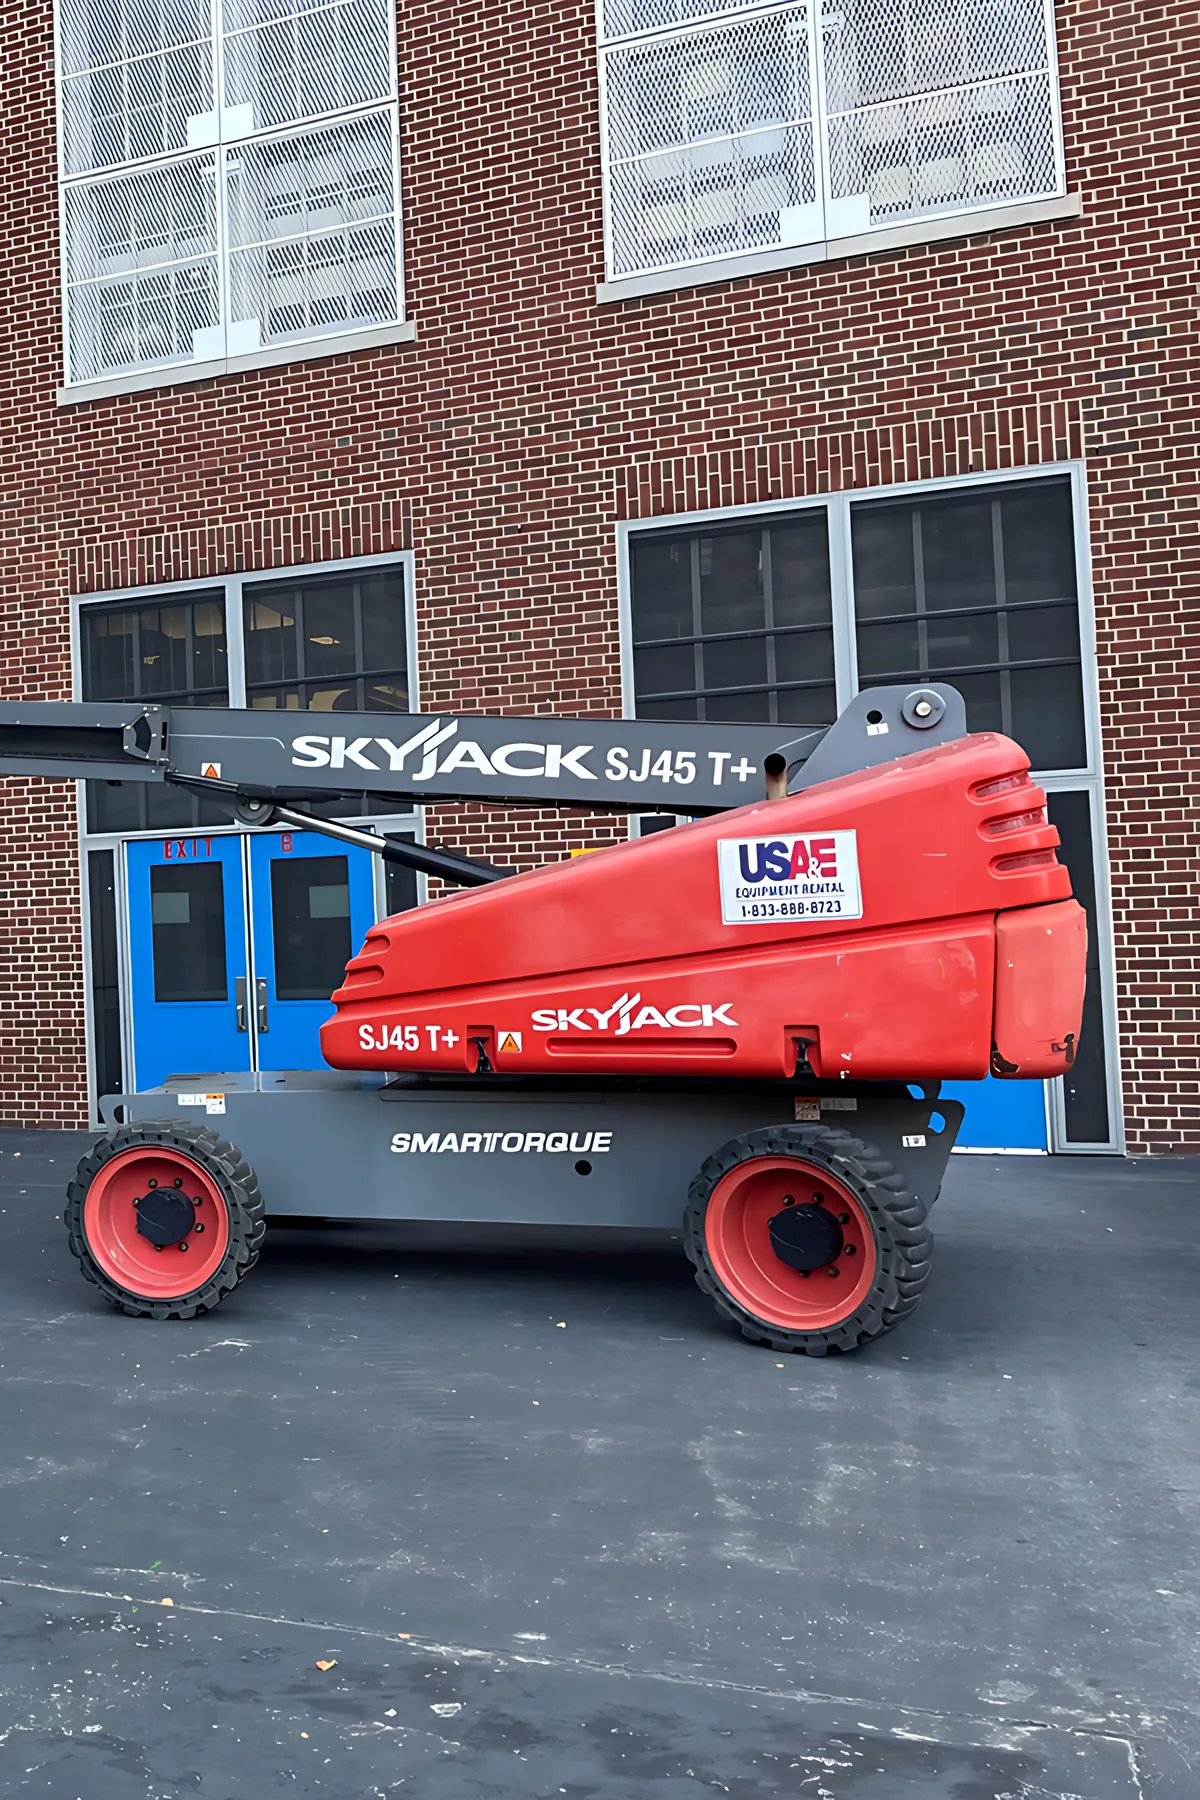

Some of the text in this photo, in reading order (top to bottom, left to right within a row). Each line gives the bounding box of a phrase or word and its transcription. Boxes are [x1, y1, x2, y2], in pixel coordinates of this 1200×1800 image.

[291, 717, 757, 786] SKYJACK SJ45 T+
[163, 837, 212, 859] EXIT
[735, 882, 846, 899] EQUIPMENT RENTAL
[531, 993, 739, 1035] SKYJACK
[358, 1024, 460, 1052] SJ45 T+
